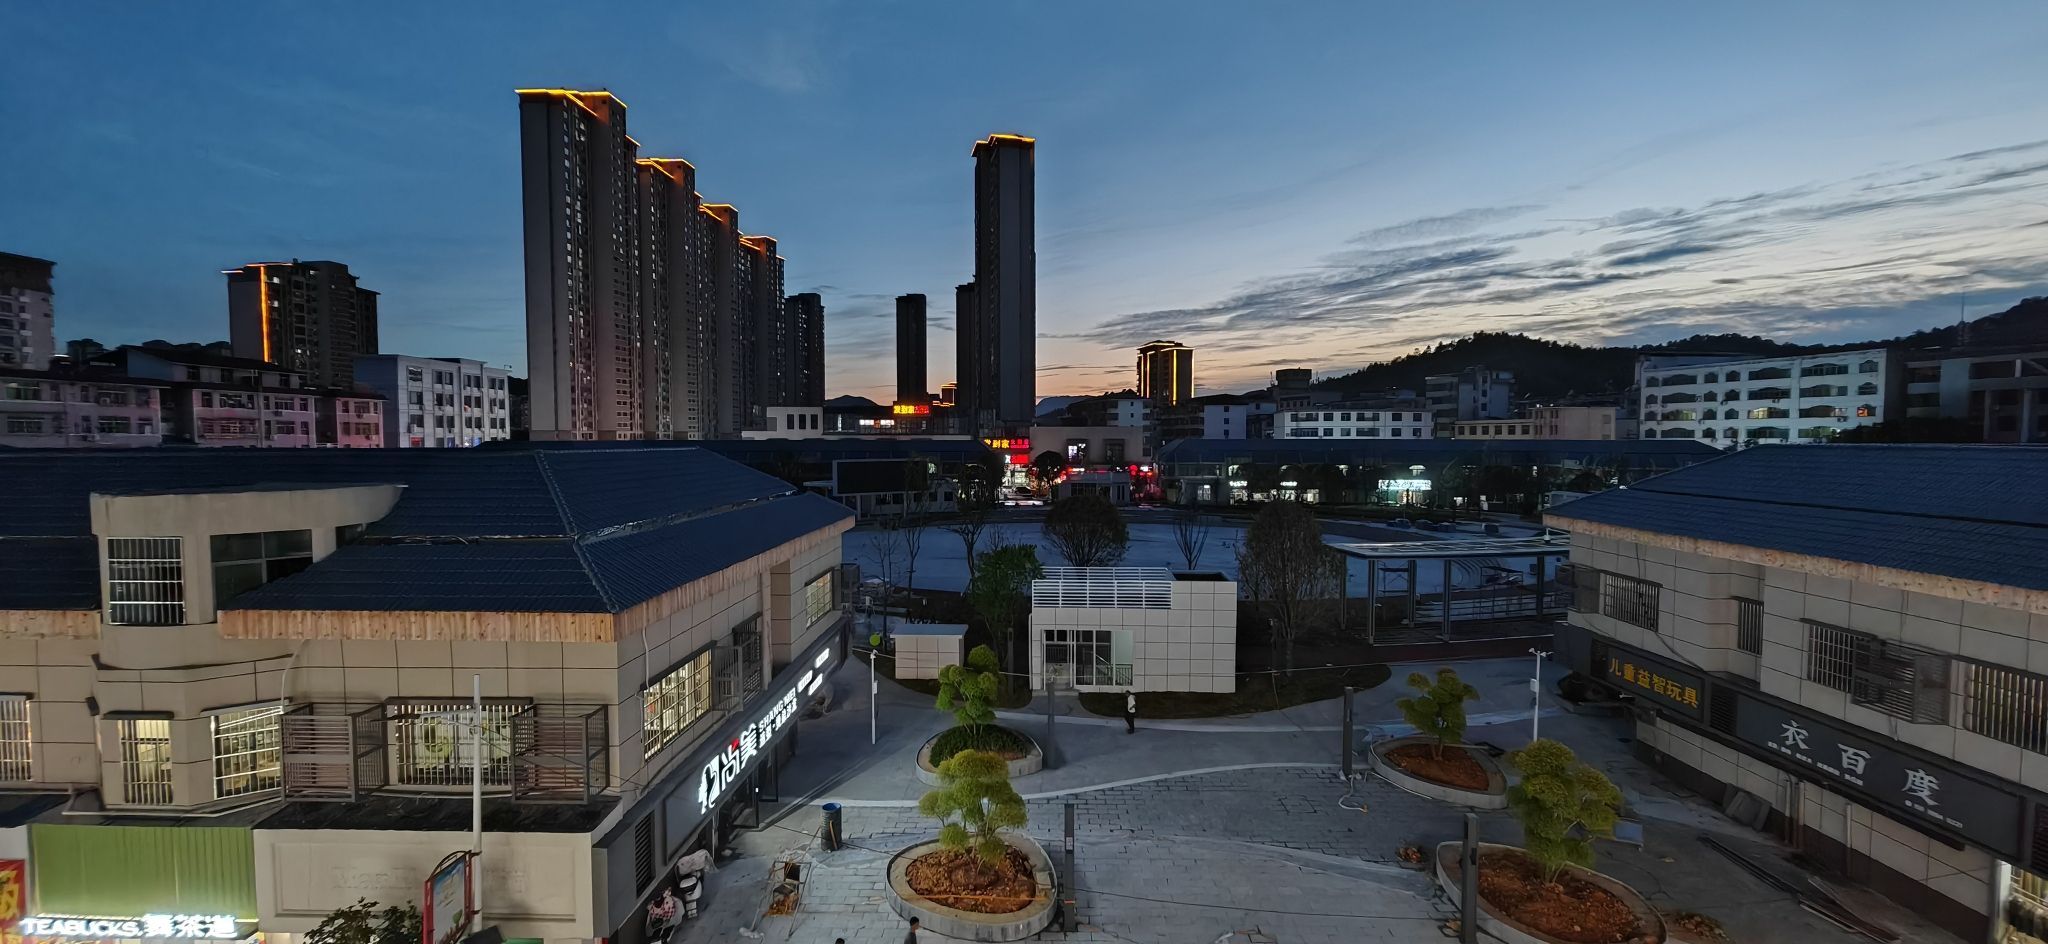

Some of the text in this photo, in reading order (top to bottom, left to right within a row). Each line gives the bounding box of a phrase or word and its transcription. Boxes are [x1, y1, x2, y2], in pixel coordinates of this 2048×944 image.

[1609, 658, 1698, 708] 儿童益智玩具
[758, 700, 784, 732] SHANG
[721, 722, 758, 791] 尚美
[1780, 720, 1940, 806] 衣百度
